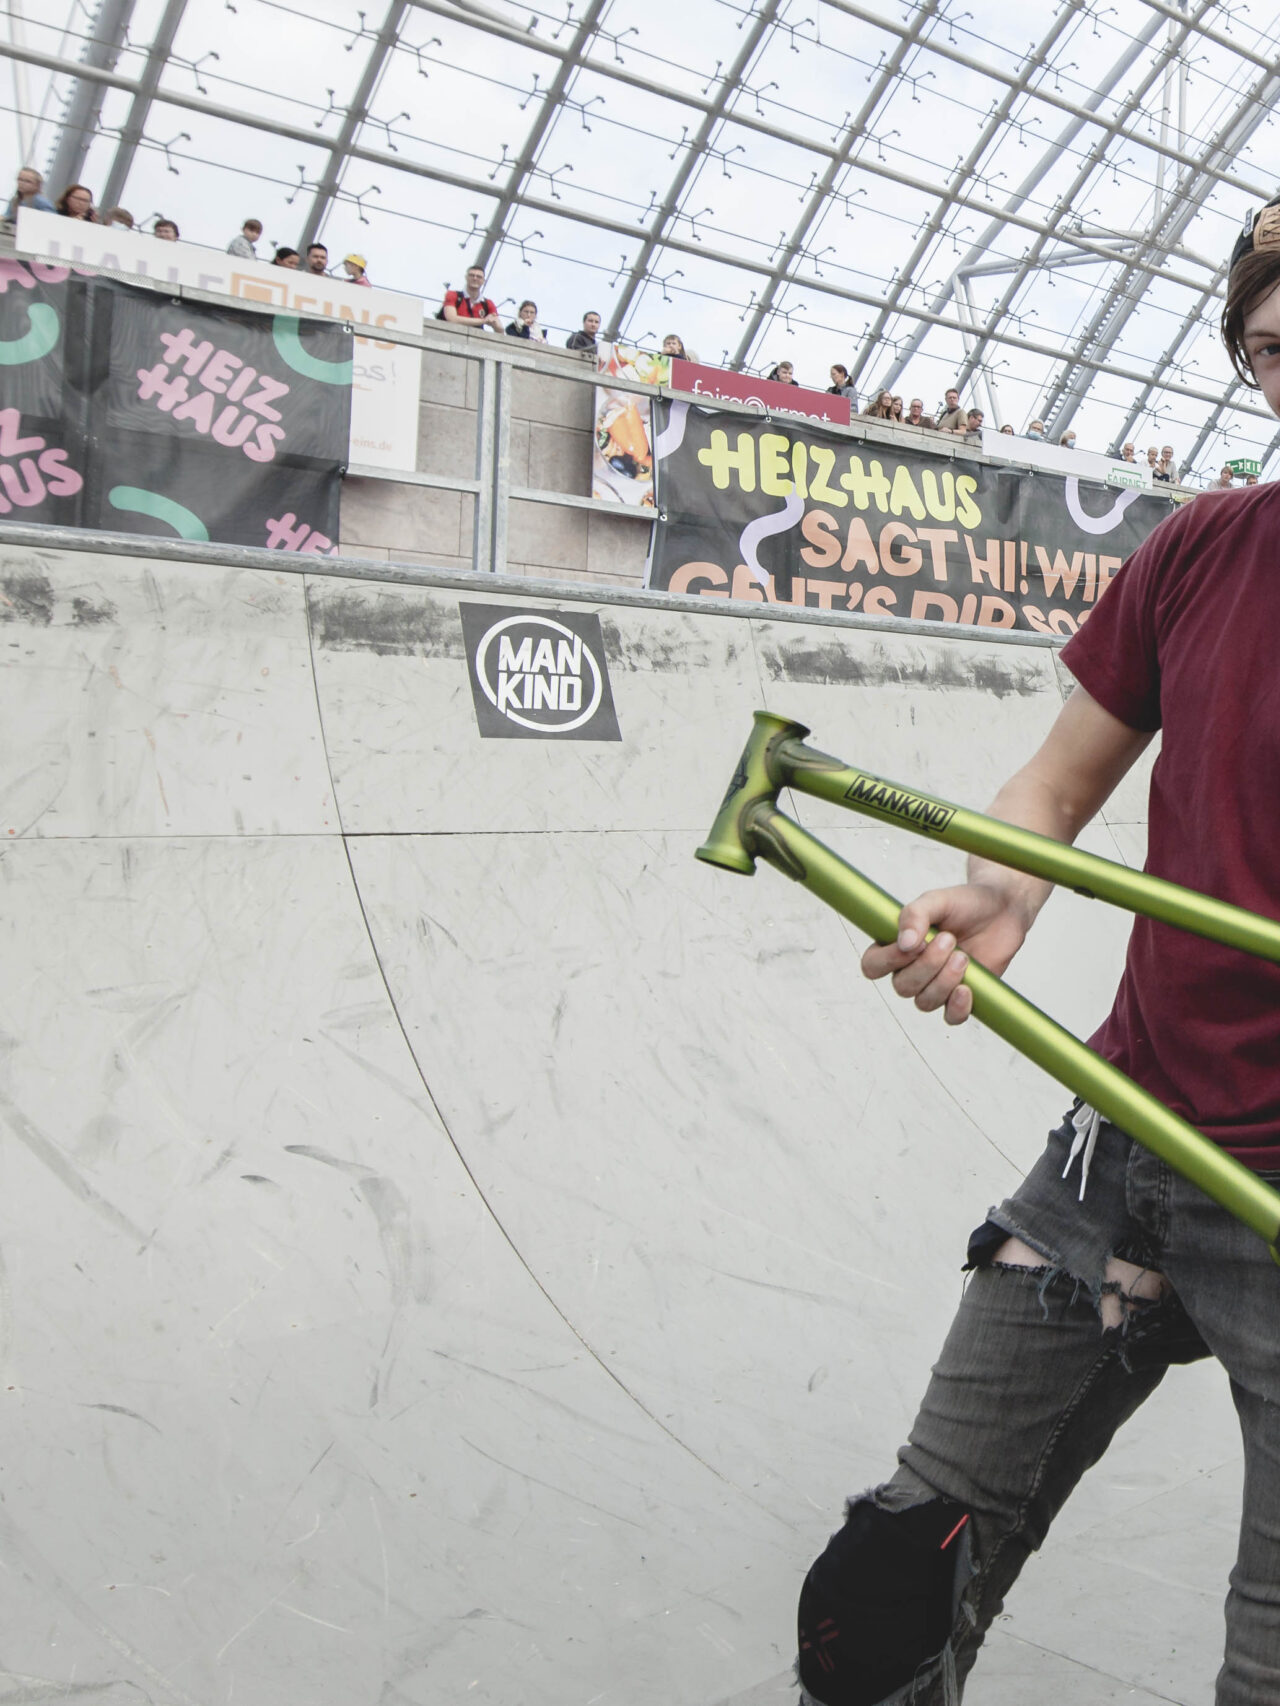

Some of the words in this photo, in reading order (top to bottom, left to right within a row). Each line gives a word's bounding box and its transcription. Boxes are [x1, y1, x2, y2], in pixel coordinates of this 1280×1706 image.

[137, 363, 286, 462] HAUS
[160, 328, 290, 422] HEIZ
[697, 429, 982, 529] HEIZHAUS
[800, 509, 958, 581] SAGT
[964, 534, 1028, 594] HI!
[497, 672, 583, 714] KIND
[498, 634, 583, 675] MAN
[850, 779, 950, 827] MANKIND
